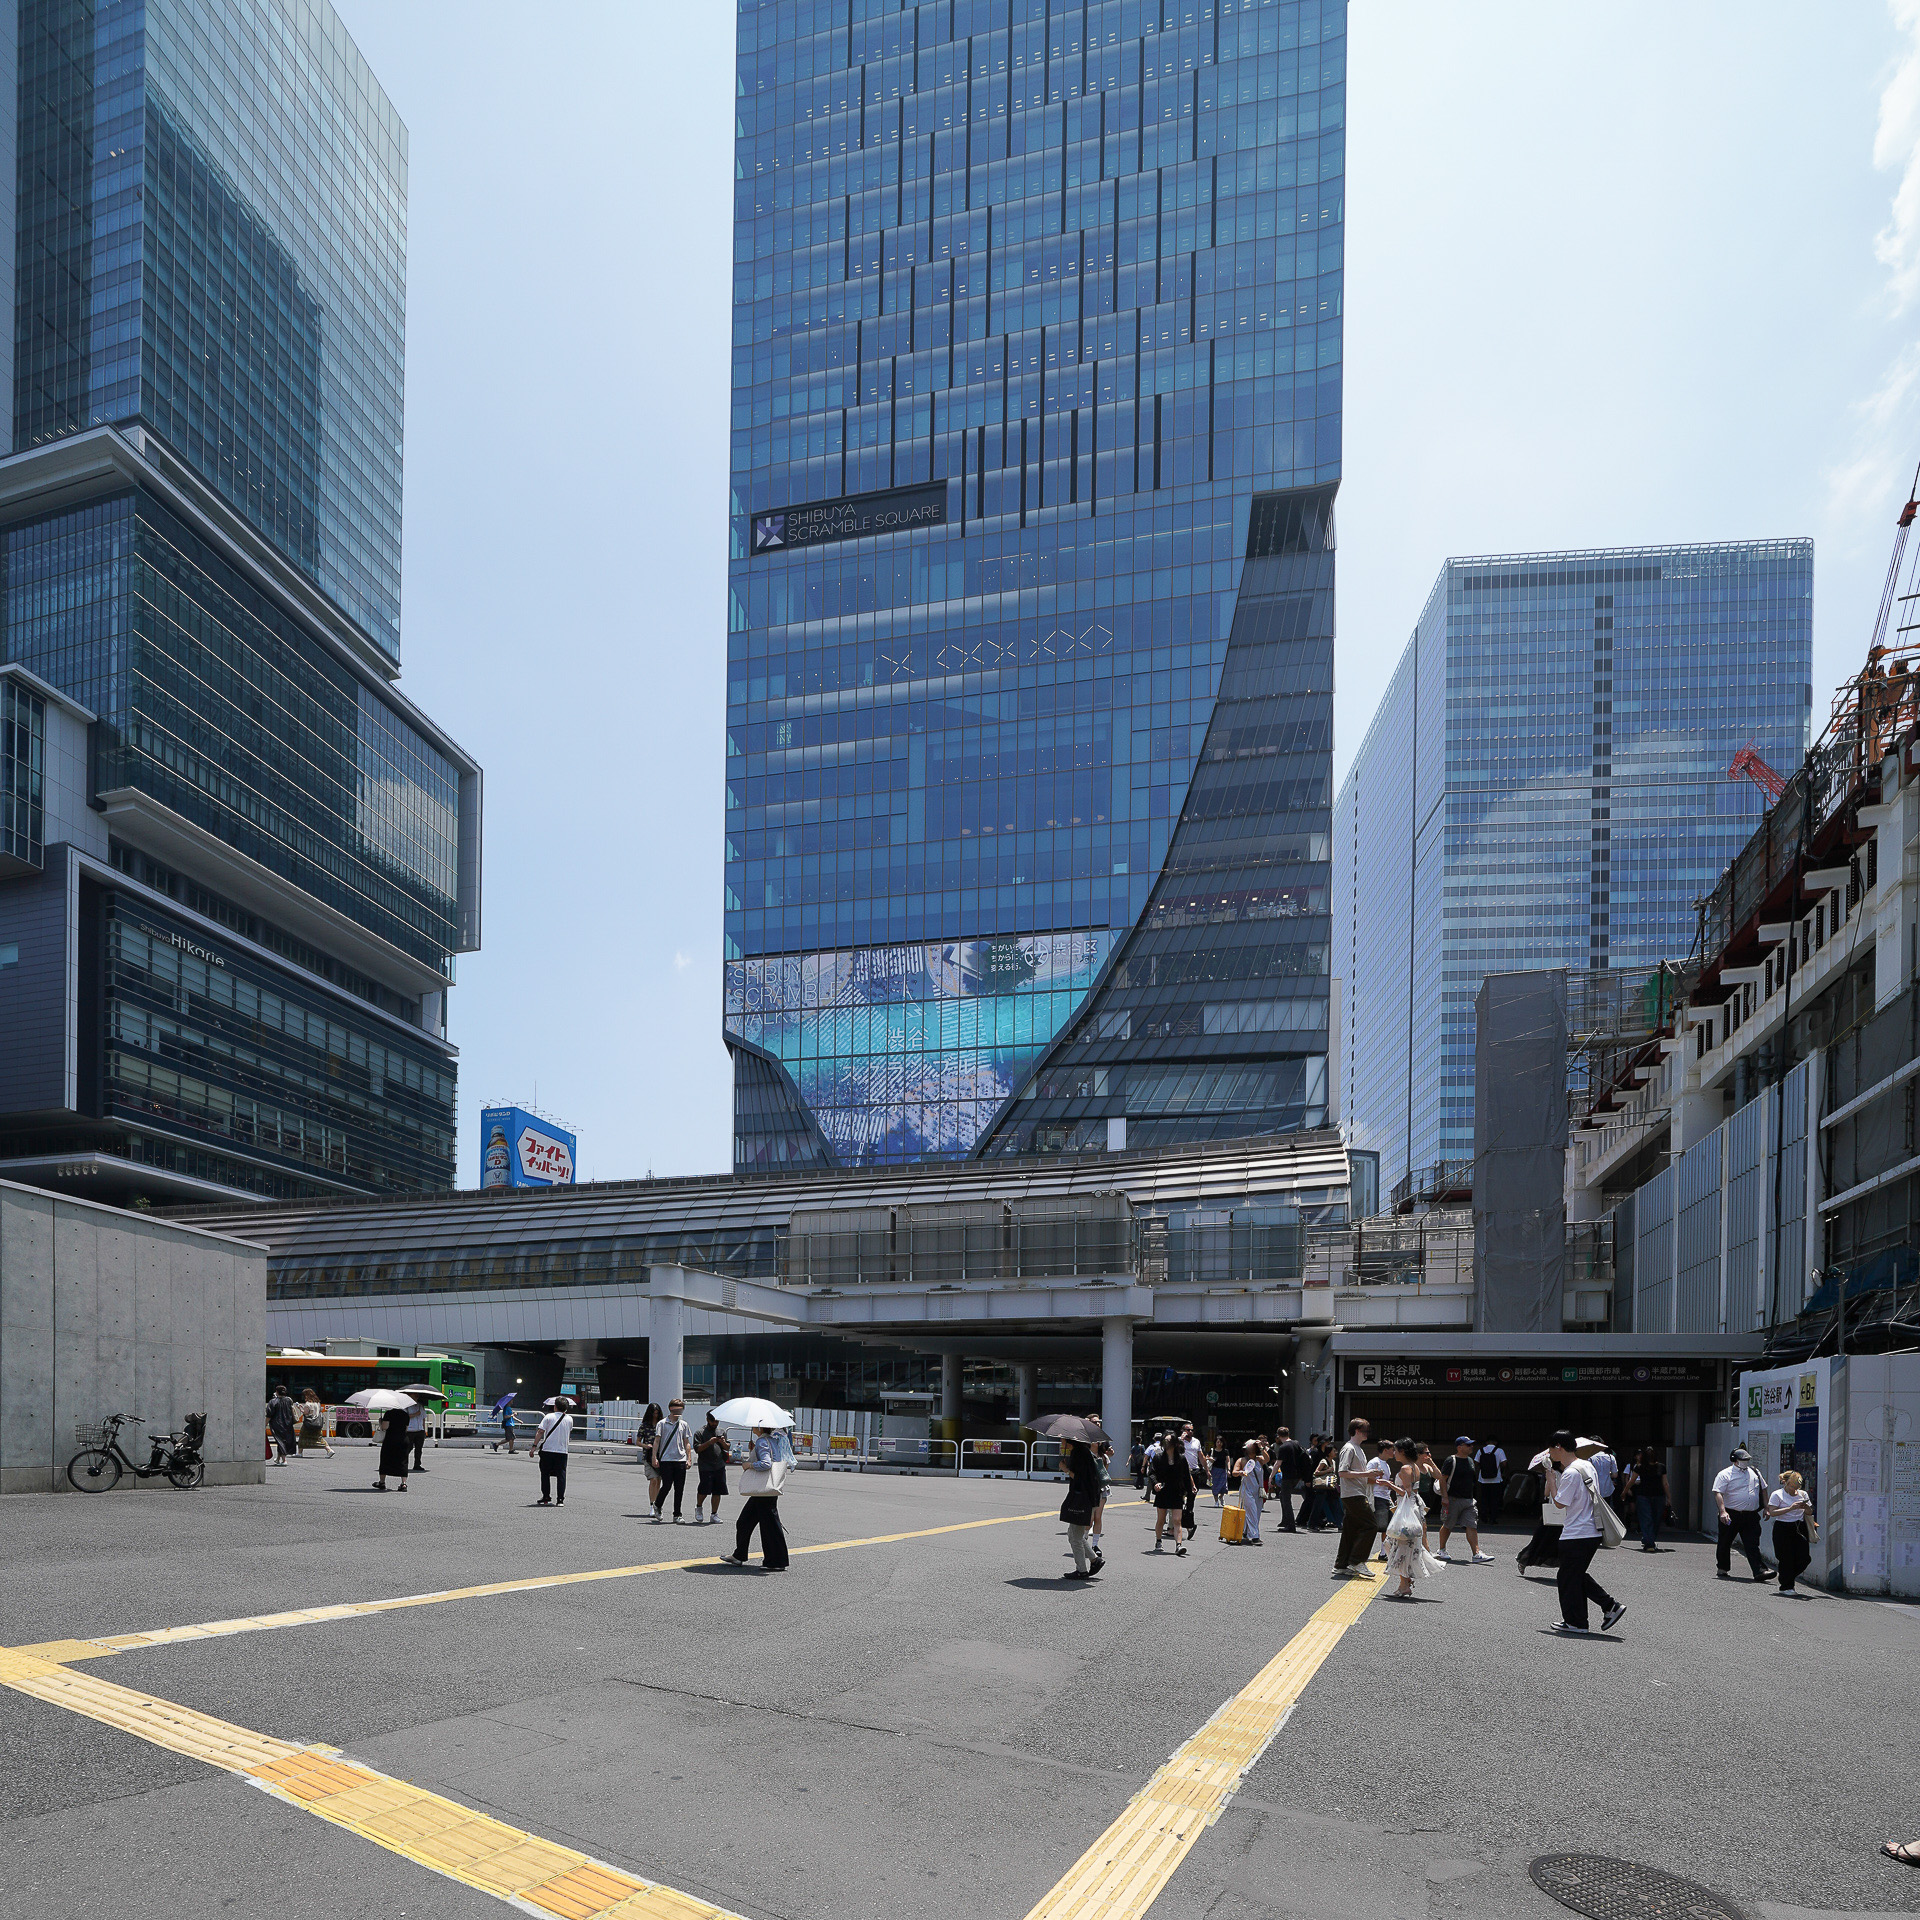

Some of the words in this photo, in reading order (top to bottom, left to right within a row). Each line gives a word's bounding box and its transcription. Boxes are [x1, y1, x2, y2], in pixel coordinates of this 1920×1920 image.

[788, 503, 856, 527] SHIBUYA
[788, 515, 872, 542] SCRAMBLE
[875, 504, 940, 528] SQUARE
[140, 923, 171, 943] Shibuya
[171, 933, 225, 967] Hikarie
[1052, 940, 1098, 956] 渋谷区
[733, 962, 816, 986] SHIBUYA
[733, 981, 841, 1007] SCRAMBLE
[733, 1005, 789, 1027] WALK
[886, 1026, 929, 1049] 渋谷
[840, 1056, 976, 1083] スクランブル
[525, 1136, 566, 1162] ファイト
[1383, 1364, 1421, 1376] 渋谷駅
[1463, 1368, 1487, 1376] 東横線
[1514, 1367, 1548, 1375] 副都心線
[1578, 1367, 1620, 1375] 田園都市線
[1651, 1366, 1687, 1374] 半蔵門線
[1383, 1377, 1418, 1386] Shibuya
[1420, 1377, 1436, 1385] Sta.
[1207, 1393, 1217, 1401] 54
[1749, 1387, 1762, 1409] JR
[1763, 1387, 1782, 1404] 渋谷駅
[1806, 1383, 1815, 1401] B7
